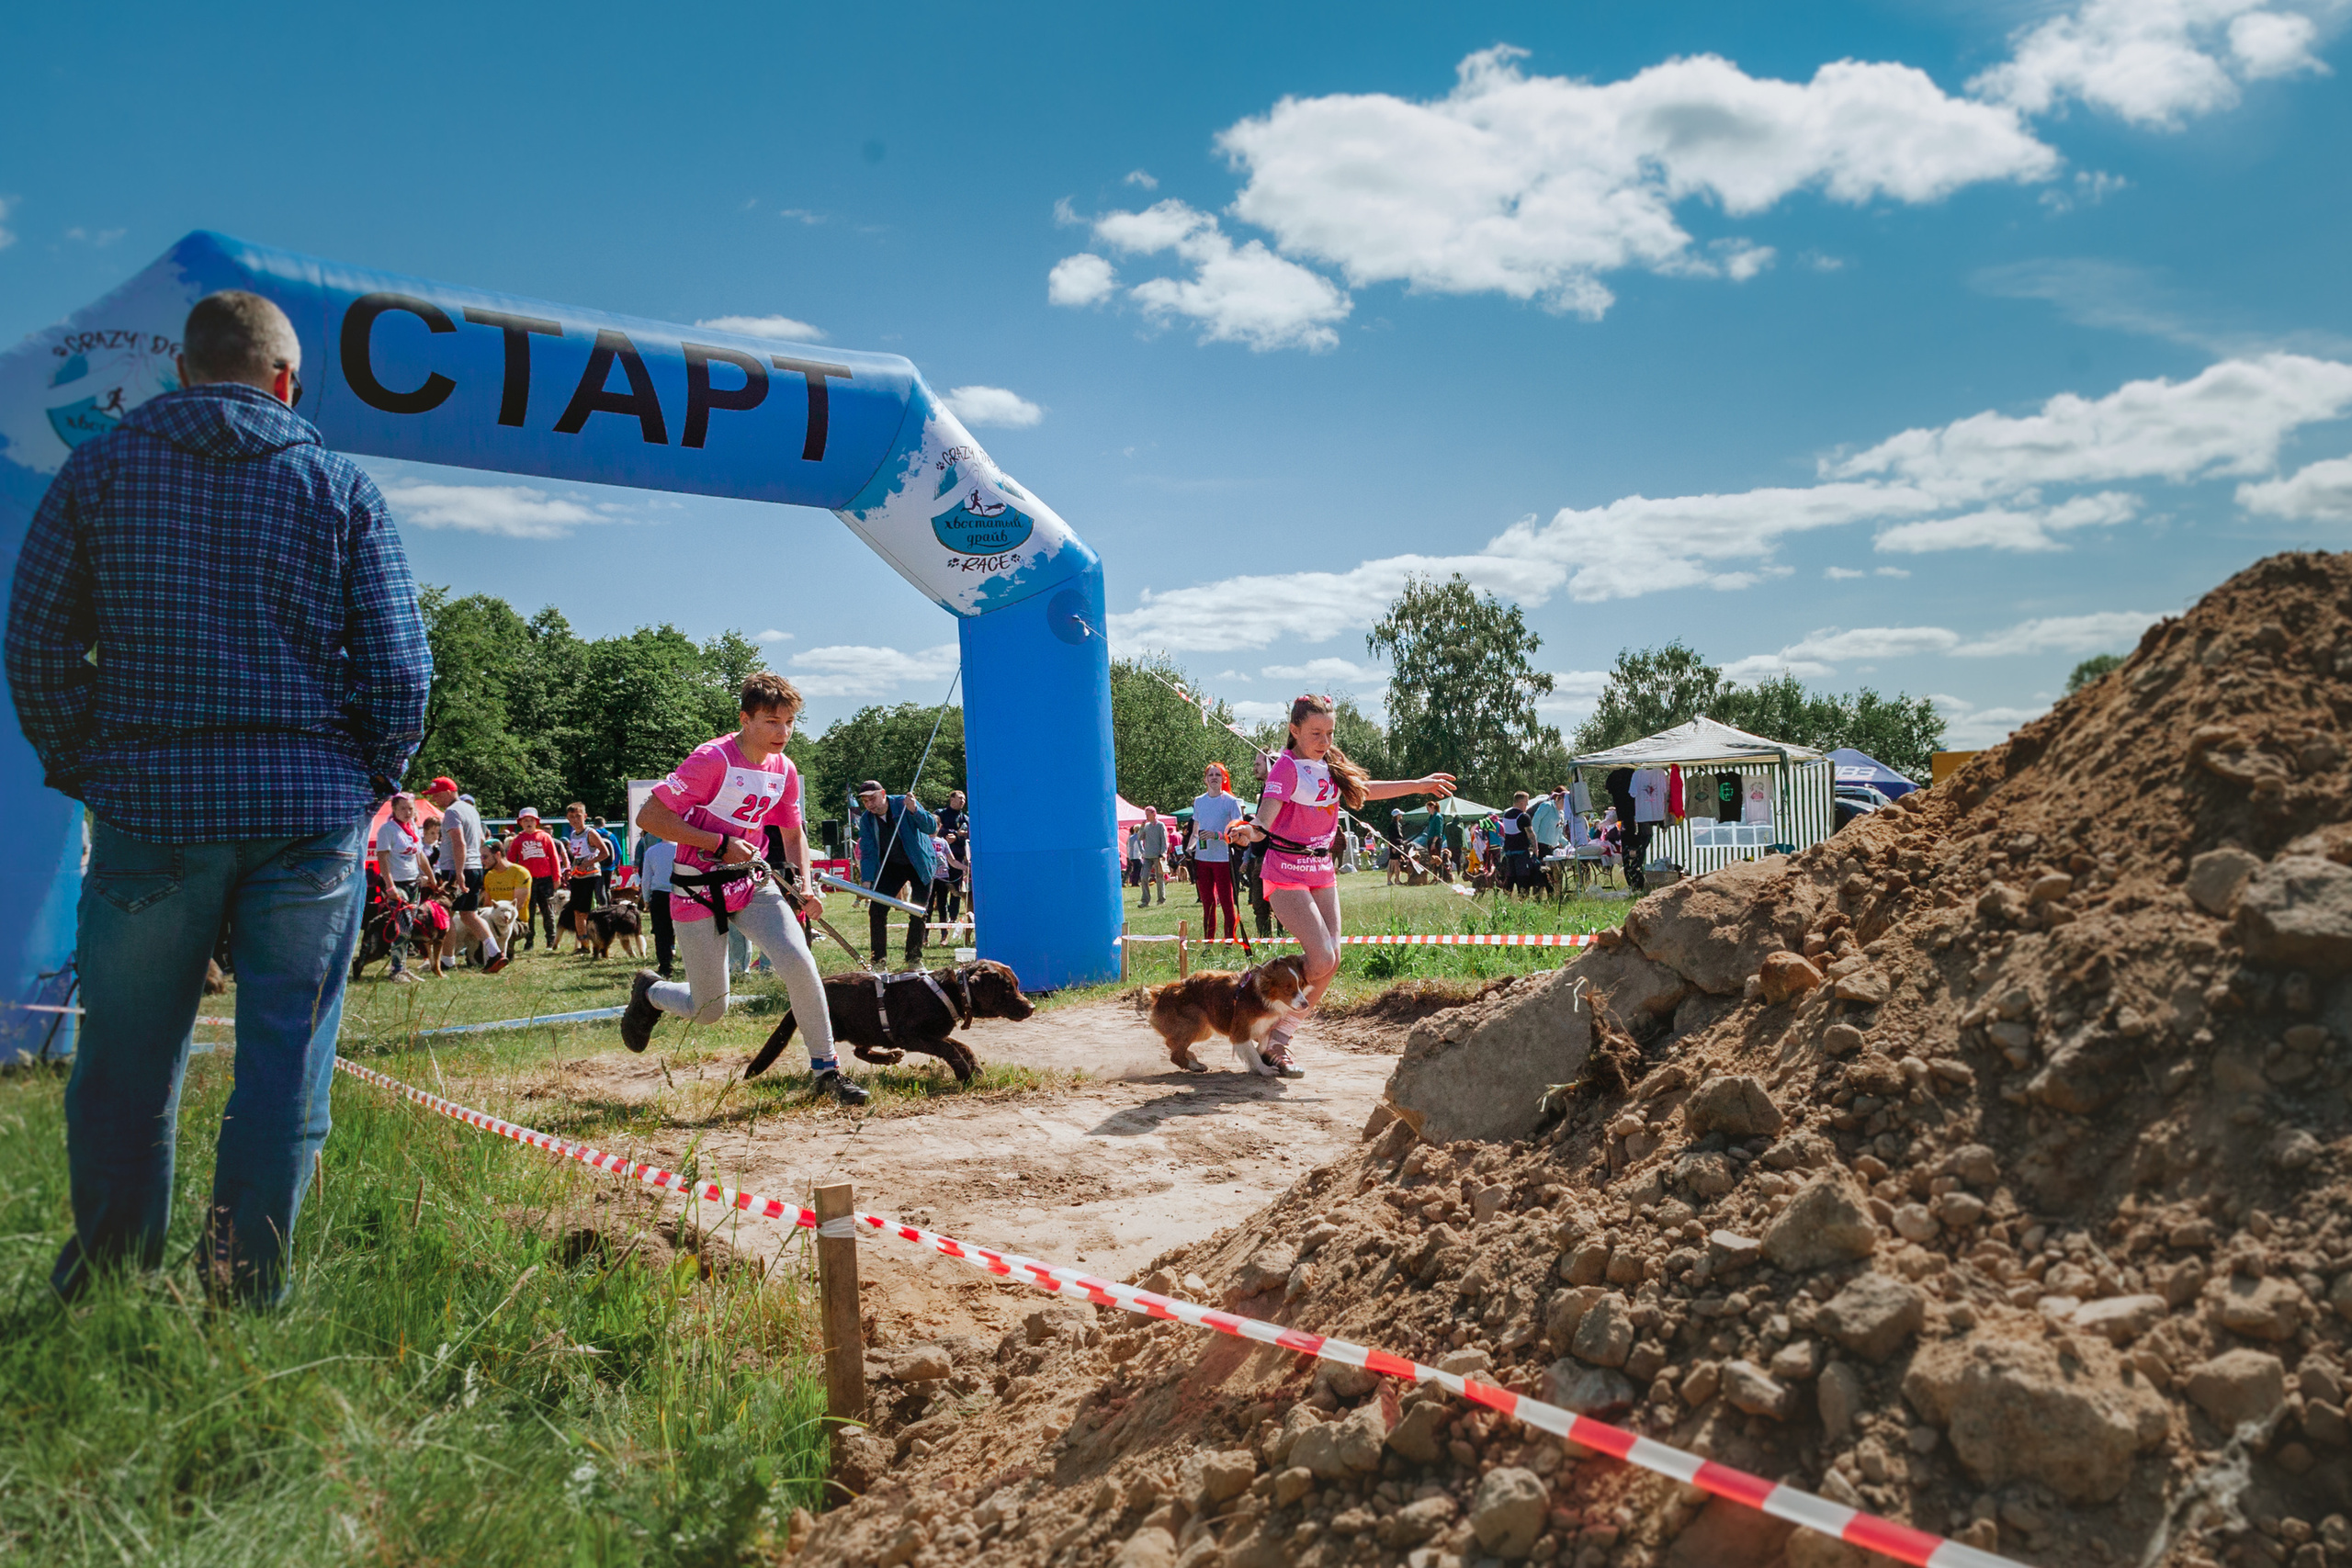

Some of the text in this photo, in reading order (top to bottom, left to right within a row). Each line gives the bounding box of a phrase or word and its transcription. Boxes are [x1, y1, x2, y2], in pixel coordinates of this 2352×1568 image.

[64, 329, 139, 354] CRAZY
[340, 292, 854, 462] СТАРТ
[942, 446, 976, 467] CRAZY
[944, 516, 1023, 530] хвостатый
[967, 530, 1010, 548] драйв
[961, 555, 1012, 573] RACE
[731, 794, 771, 823] 22
